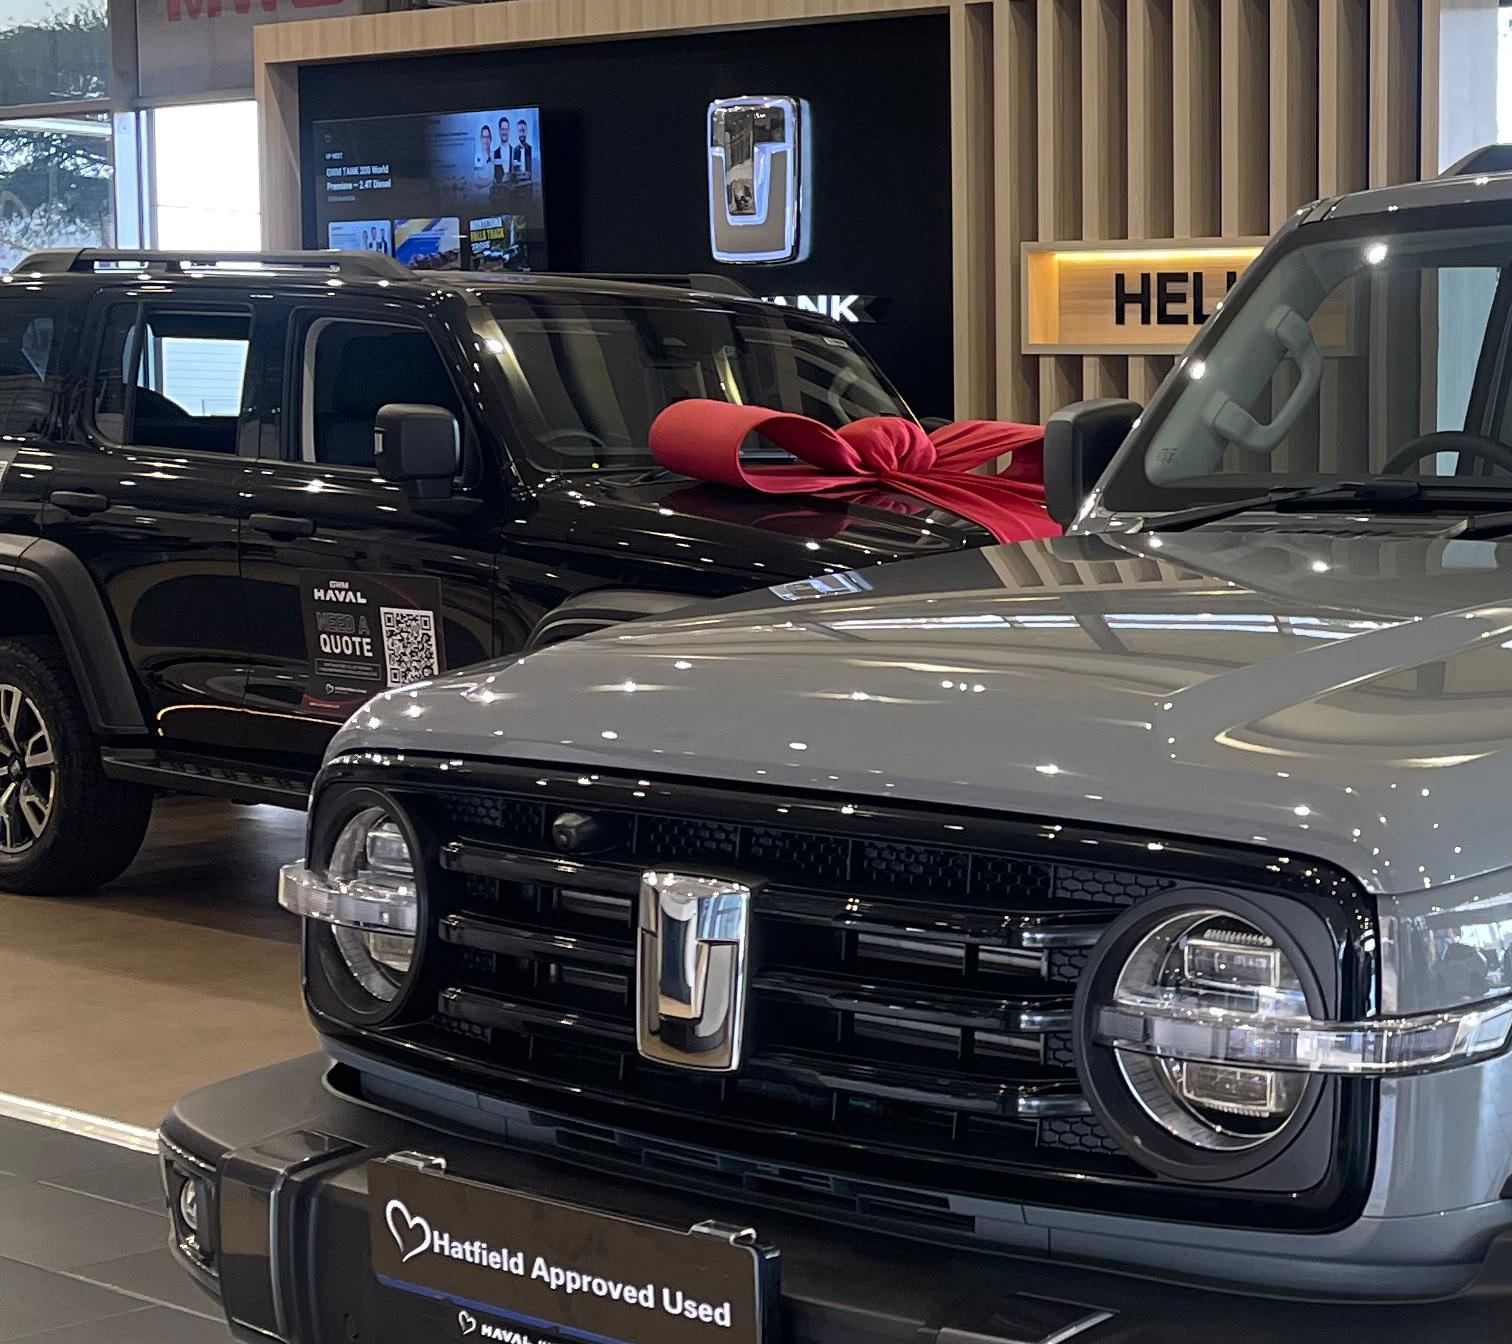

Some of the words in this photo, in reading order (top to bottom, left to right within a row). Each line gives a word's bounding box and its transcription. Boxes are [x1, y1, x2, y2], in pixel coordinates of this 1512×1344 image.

[761, 294, 859, 323] NK
[313, 588, 368, 604] HAVAL
[315, 612, 354, 634] NEED
[358, 615, 371, 635] A
[319, 634, 374, 657] QUOTE
[432, 1229, 525, 1276] Hatfield
[530, 1256, 656, 1309] Approved
[661, 1287, 732, 1328] Used
